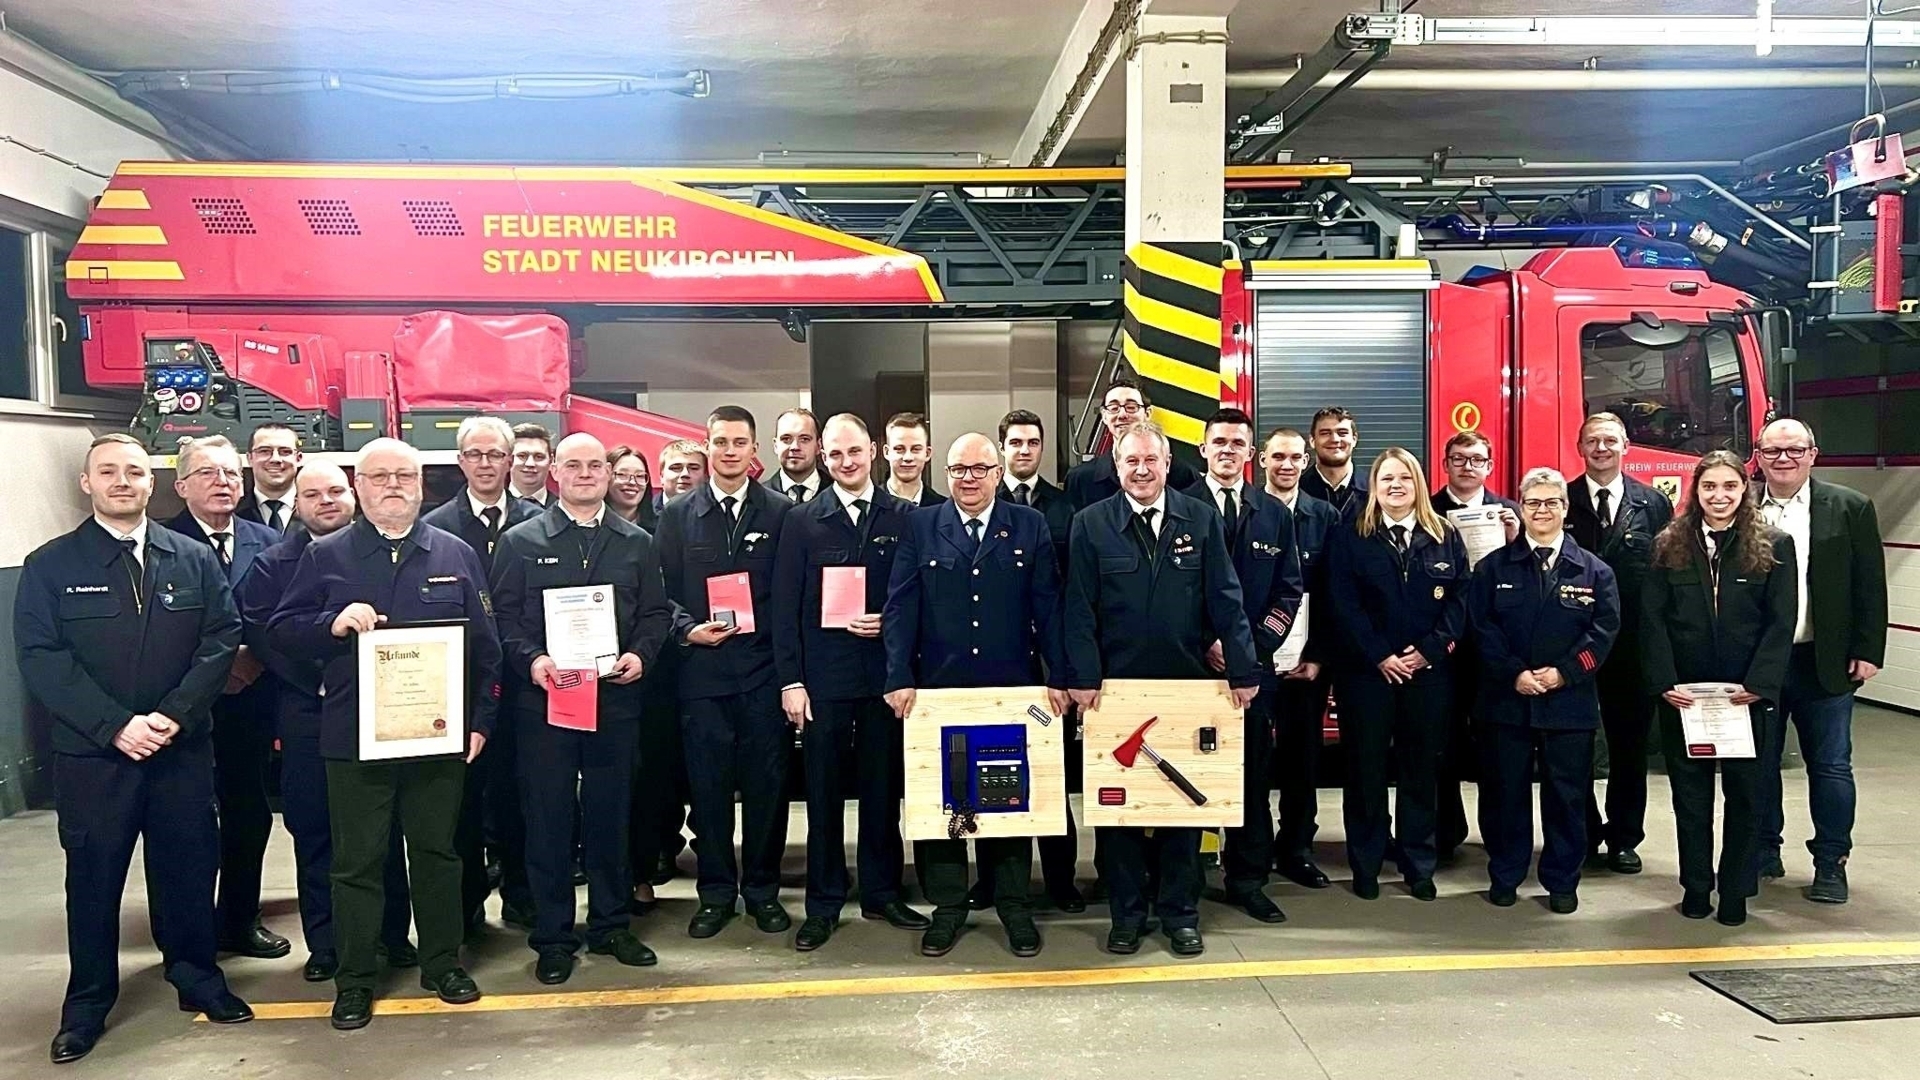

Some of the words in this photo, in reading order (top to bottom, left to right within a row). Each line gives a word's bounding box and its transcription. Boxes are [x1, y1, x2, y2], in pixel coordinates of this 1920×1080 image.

[483, 215, 677, 238] FEUERWEHR
[483, 250, 581, 273] STADT
[592, 250, 796, 273] NEUKIRCHEN
